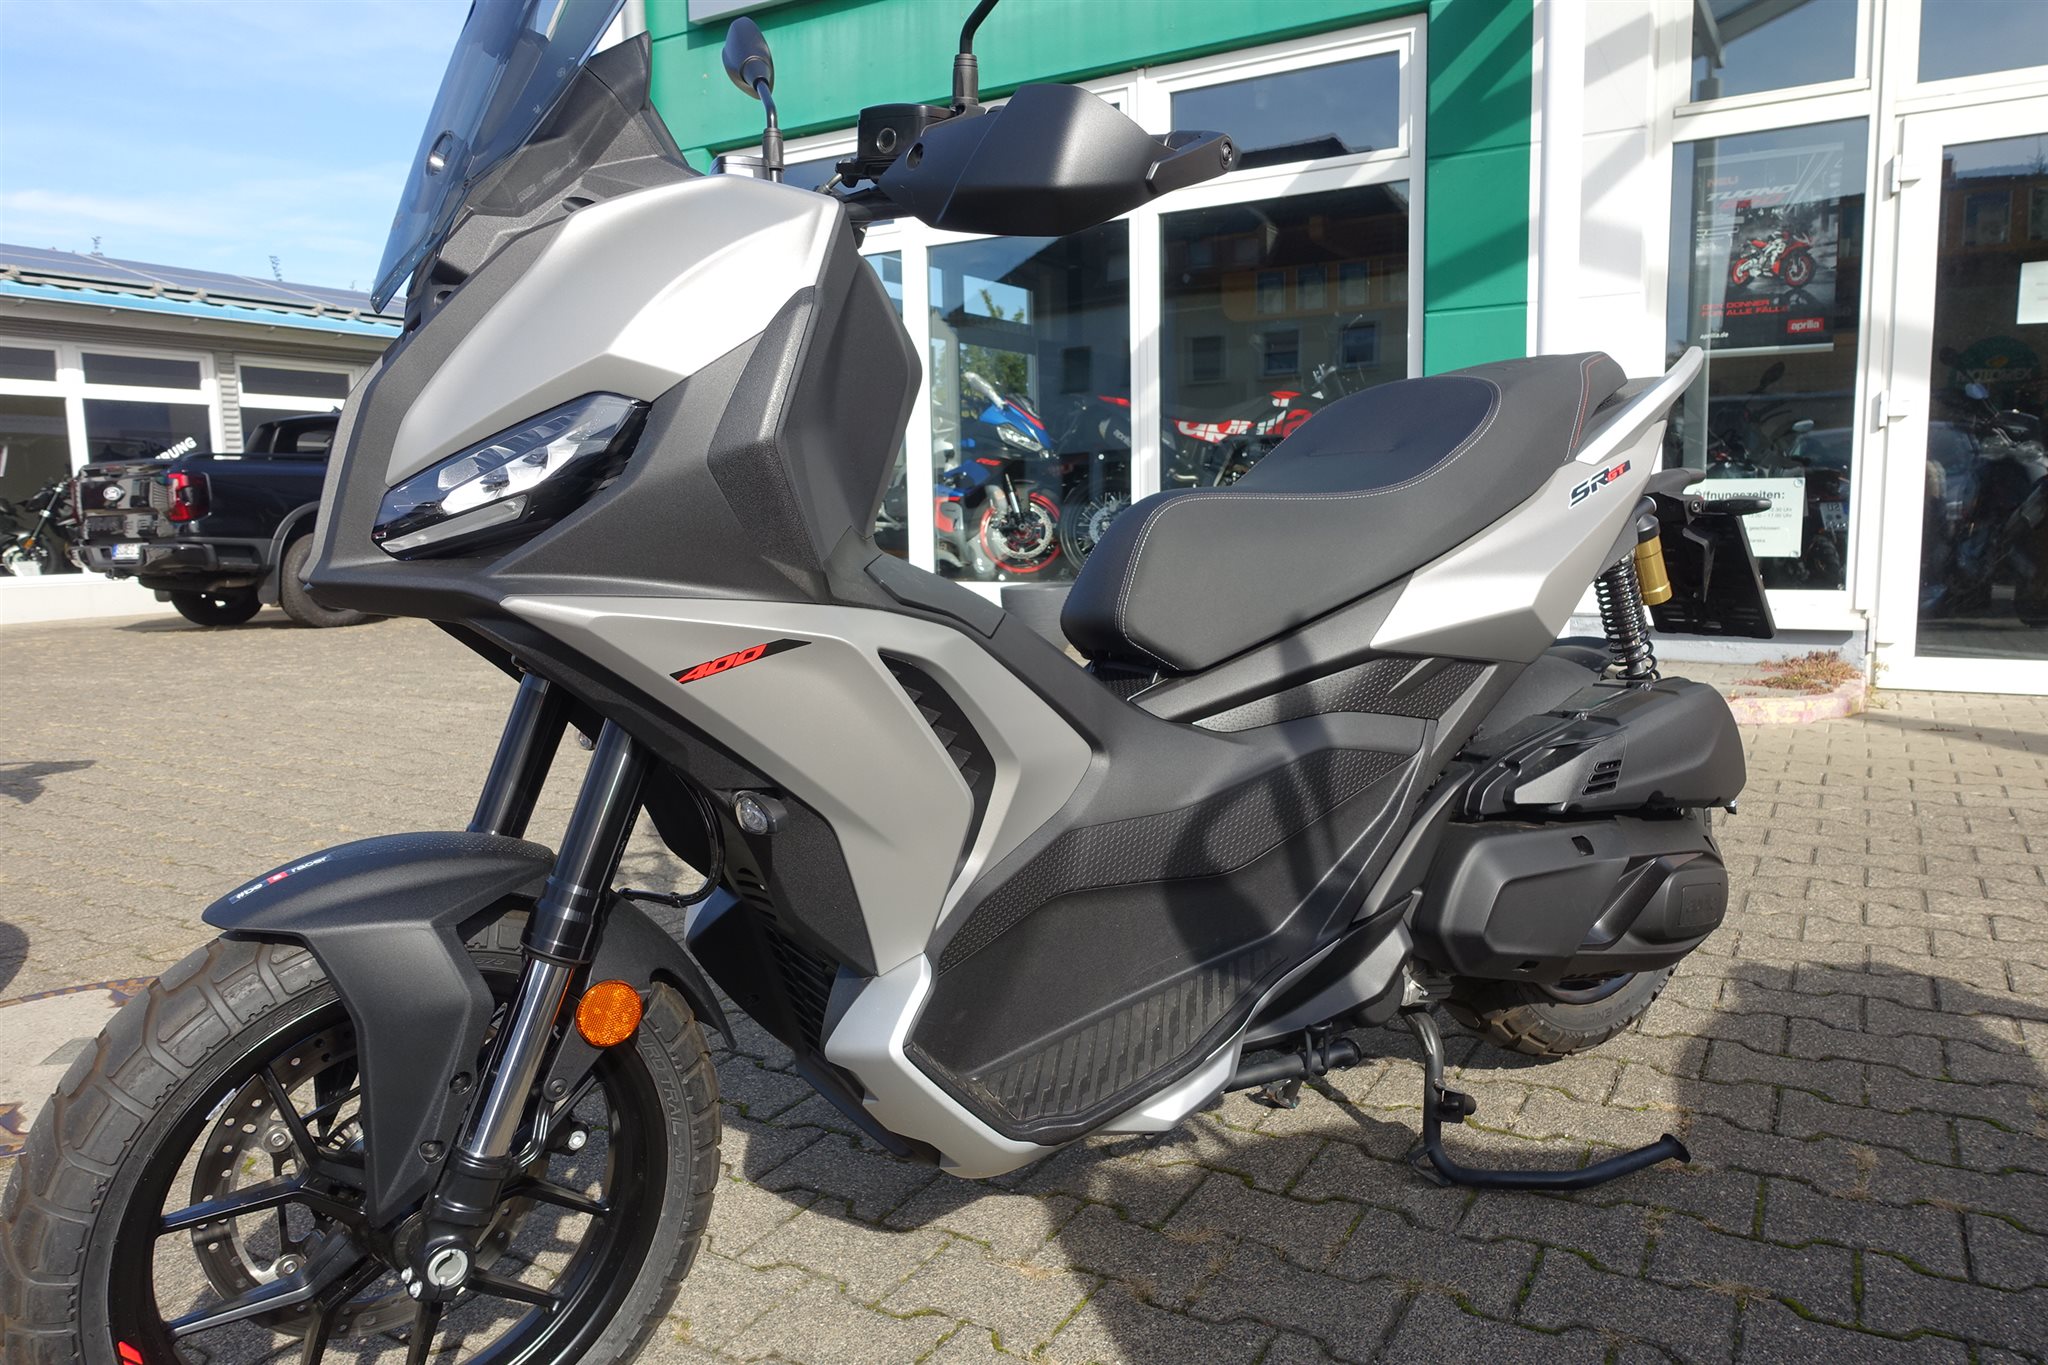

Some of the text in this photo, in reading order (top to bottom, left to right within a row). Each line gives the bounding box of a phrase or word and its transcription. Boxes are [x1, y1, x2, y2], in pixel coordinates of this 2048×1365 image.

[1706, 184, 1798, 201] TUONO
[1726, 299, 1770, 309] DONNER
[1726, 308, 1752, 316] ALLE
[1791, 320, 1820, 331] aprilia
[677, 643, 769, 683] 400
[291, 856, 328, 873] racer
